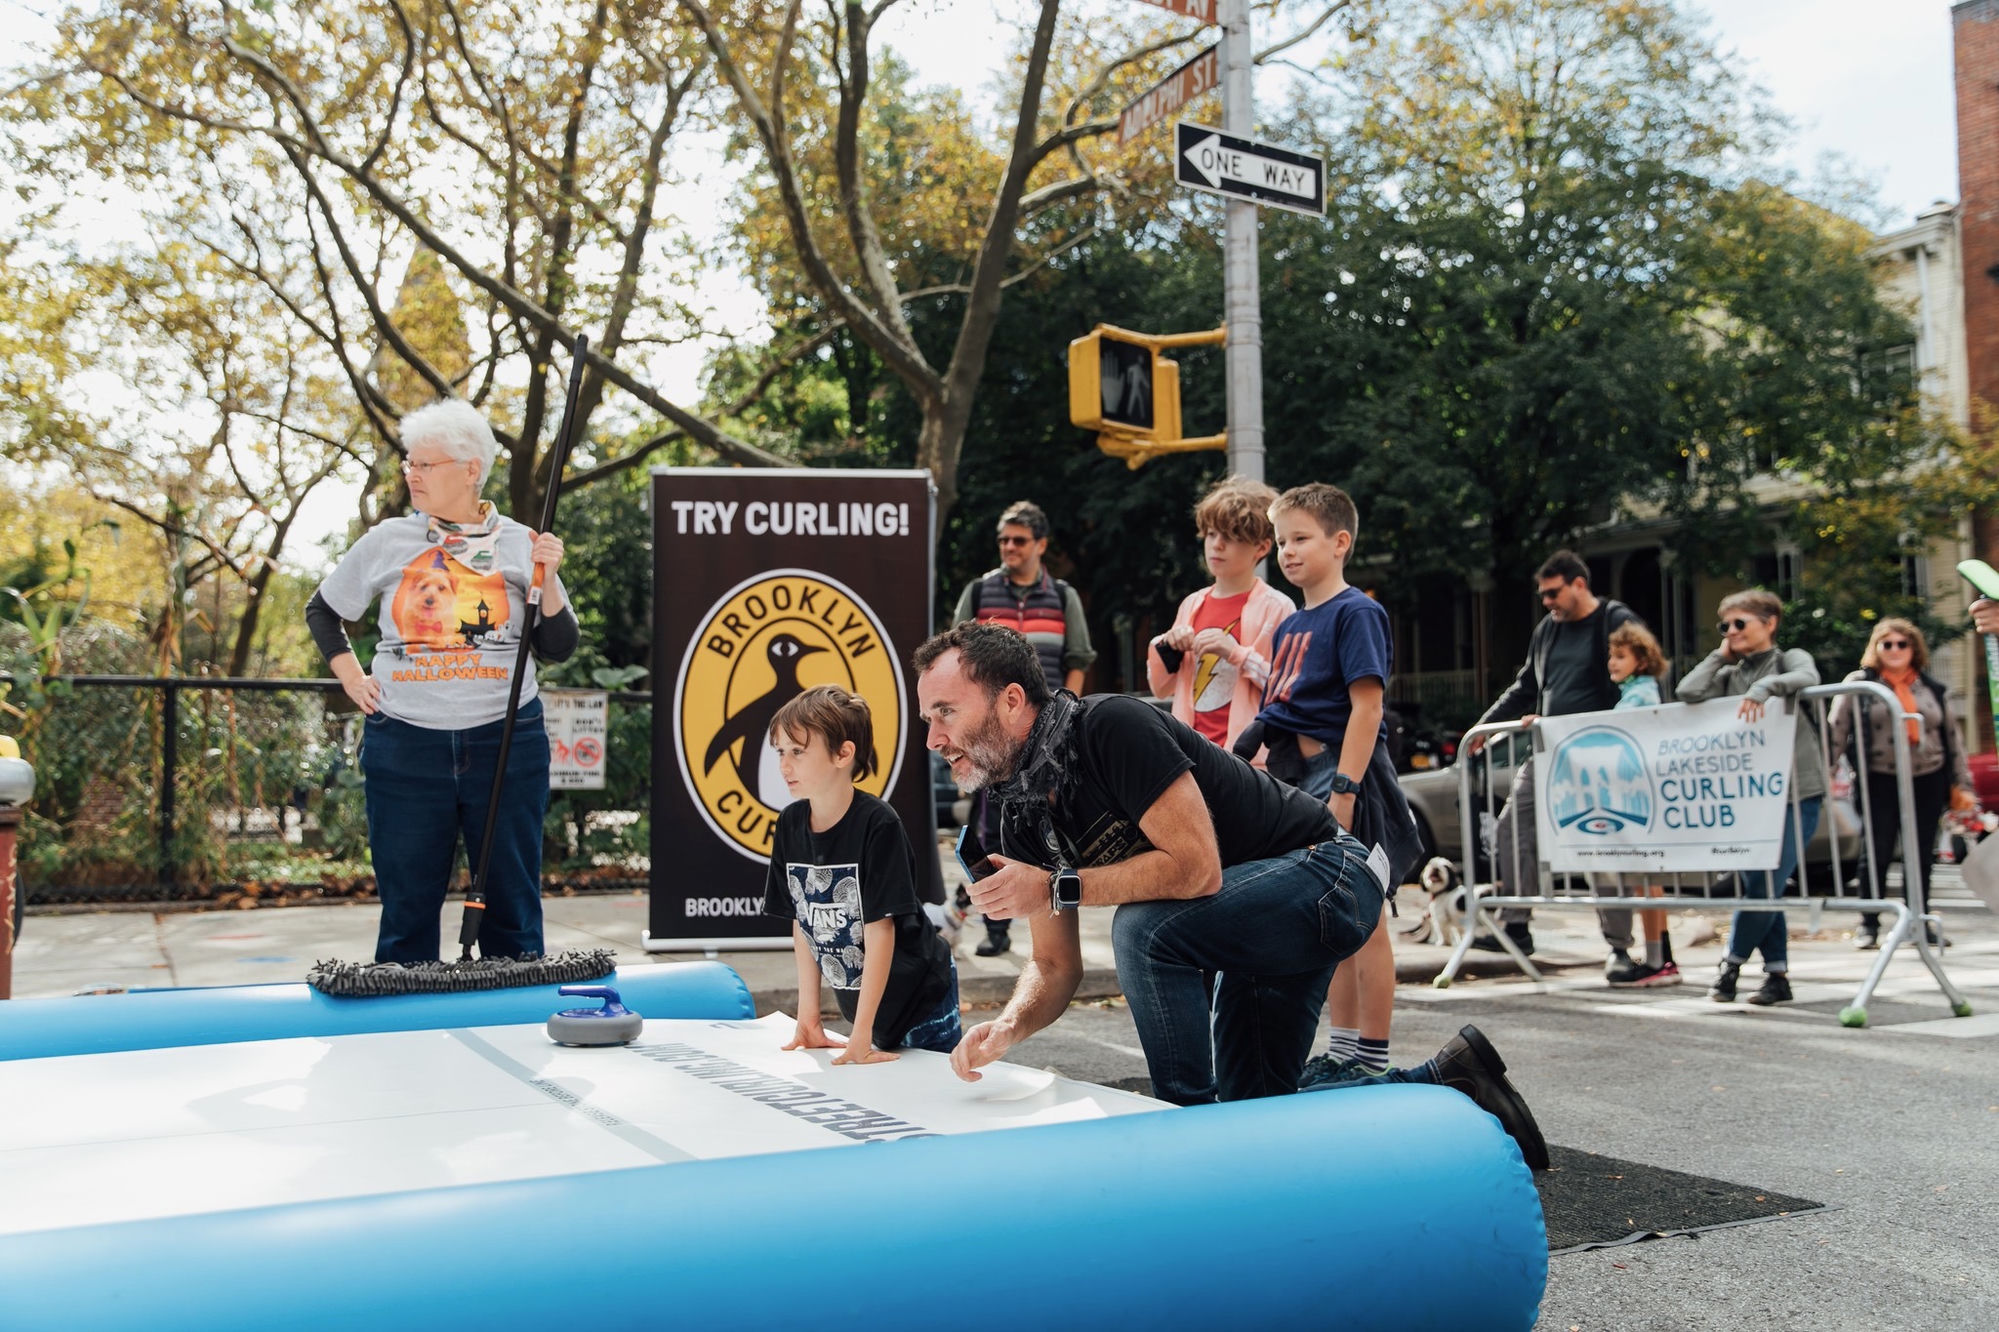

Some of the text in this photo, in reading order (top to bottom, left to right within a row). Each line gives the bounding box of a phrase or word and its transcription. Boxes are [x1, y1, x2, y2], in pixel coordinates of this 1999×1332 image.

[1191, 52, 1215, 95] ST
[1201, 147, 1305, 191] ONE WAY
[671, 500, 910, 537] TRY CURLING!
[706, 584, 877, 659] BROOKLYN
[415, 652, 482, 667] HAPPY
[391, 666, 509, 682] HALLOWEEN
[1657, 729, 1766, 757] BROOKLYN
[1655, 752, 1753, 778] LAKESIDE
[1660, 771, 1783, 802] CURLING
[1663, 804, 1735, 830] CLUB
[804, 902, 848, 929] VANS
